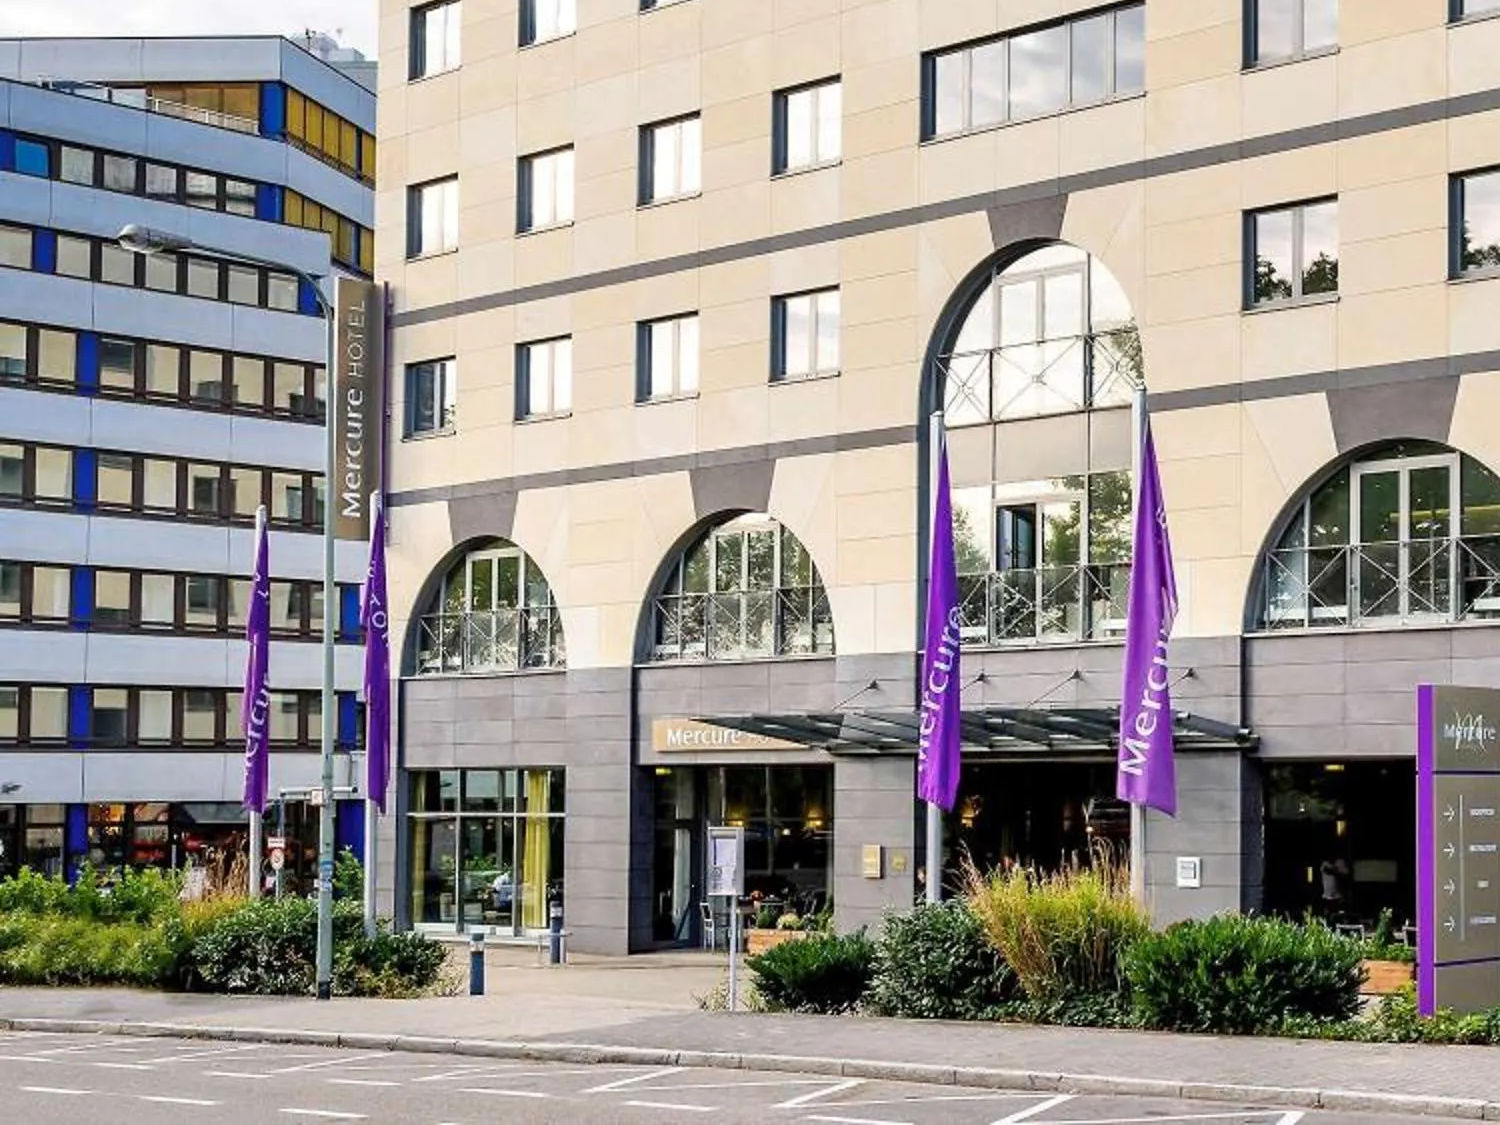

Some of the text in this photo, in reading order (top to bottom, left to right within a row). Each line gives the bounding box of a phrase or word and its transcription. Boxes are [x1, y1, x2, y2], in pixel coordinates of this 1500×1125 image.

[341, 299, 366, 518] Mercure HOTEL
[665, 727, 741, 747] Mercure
